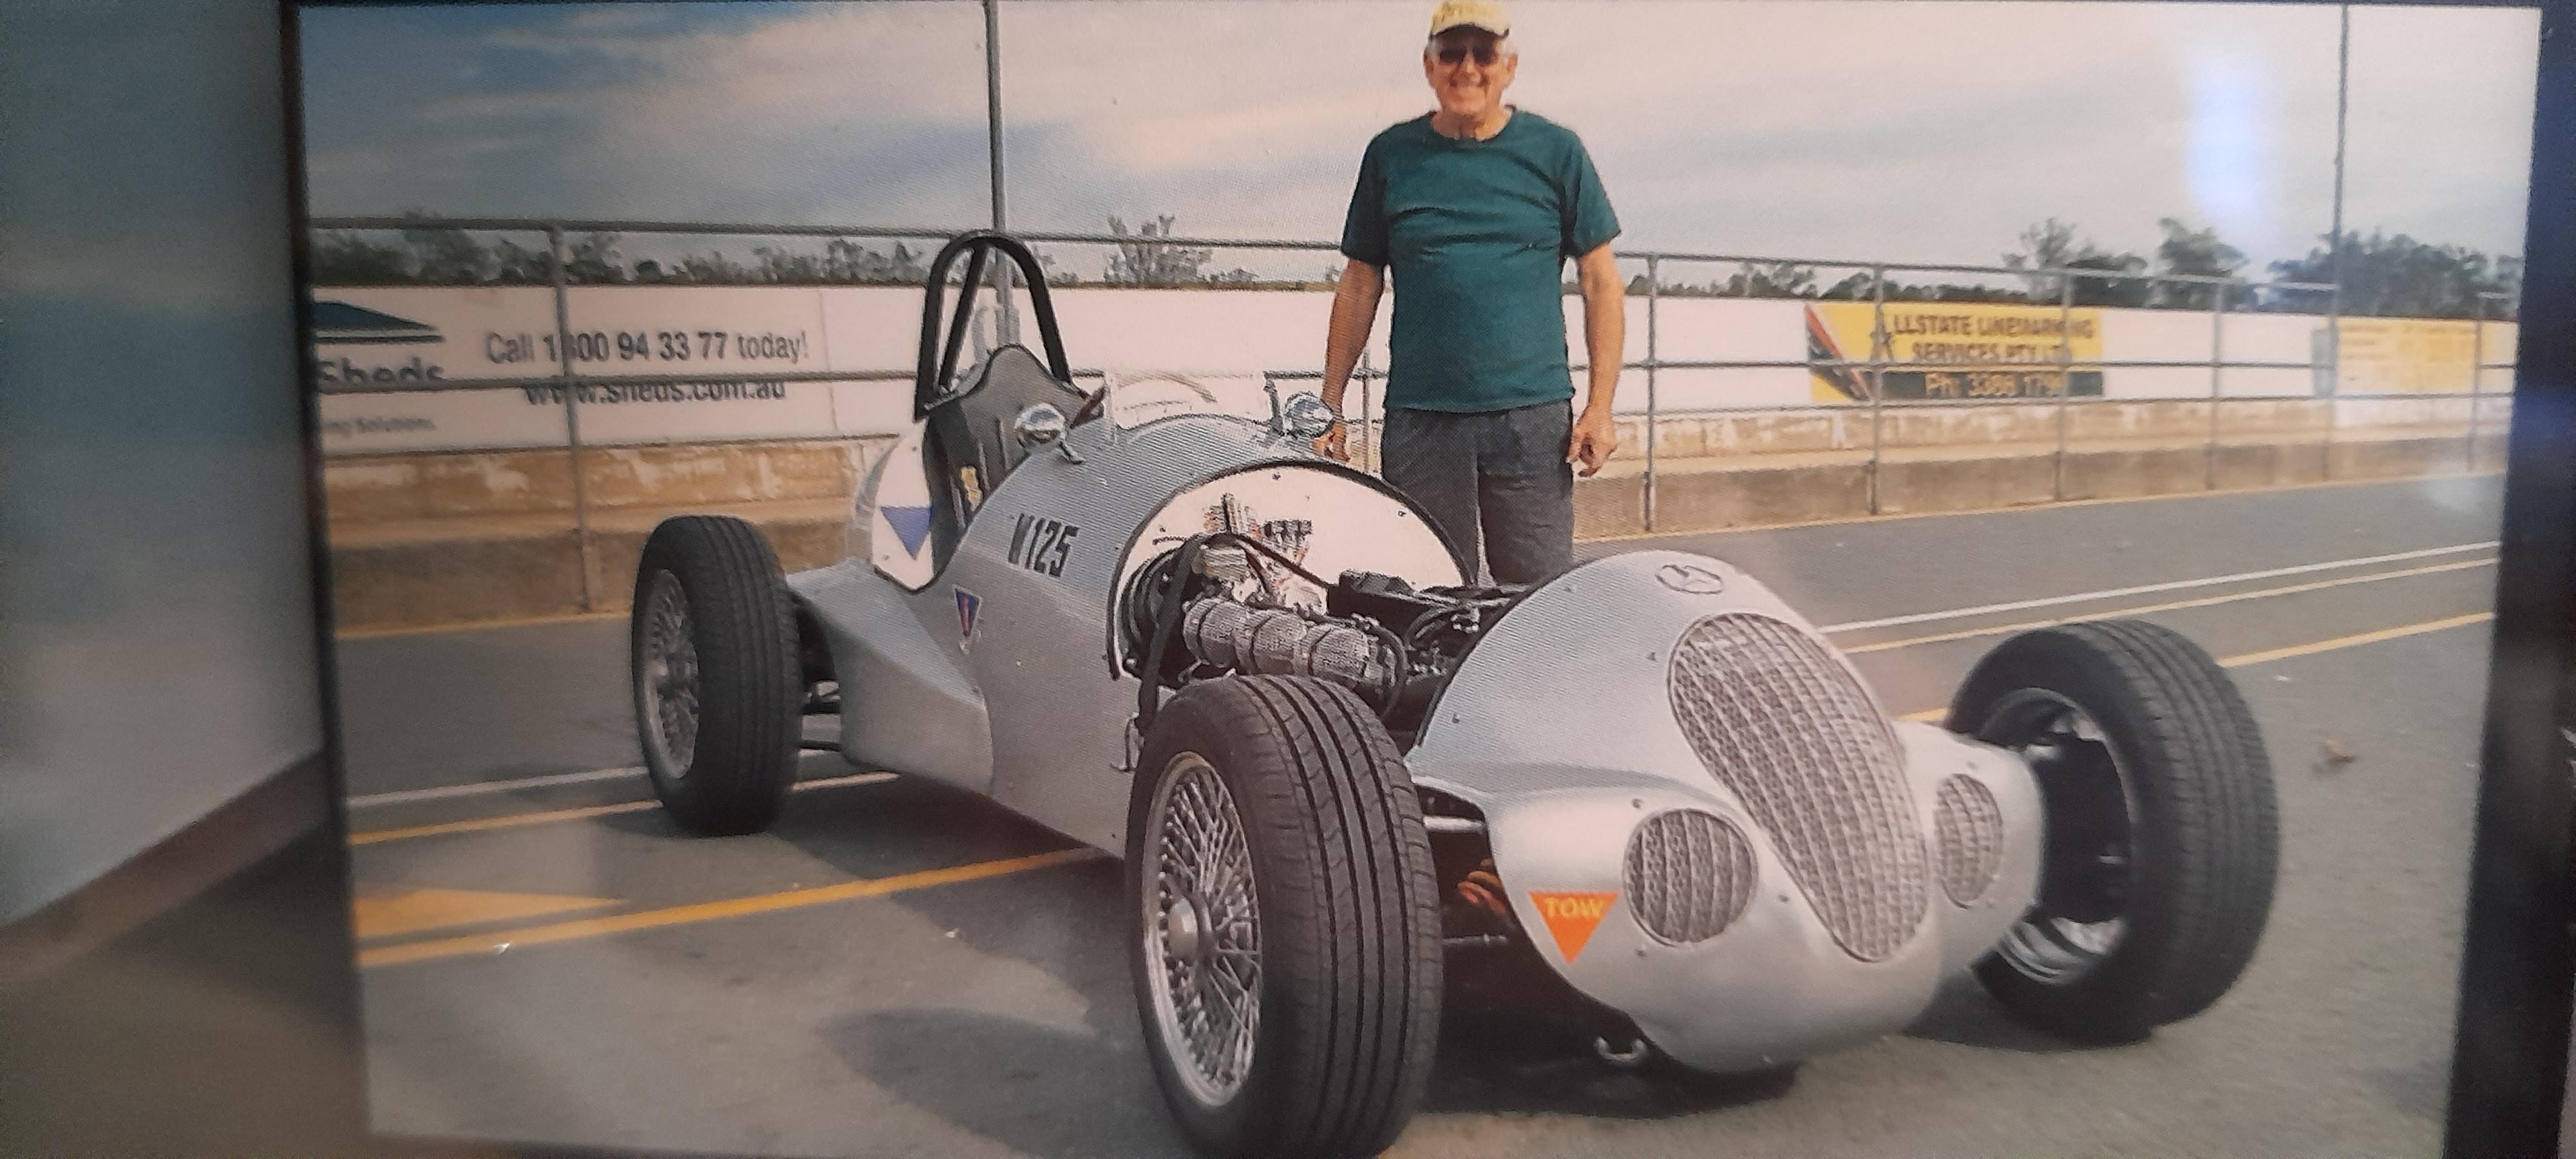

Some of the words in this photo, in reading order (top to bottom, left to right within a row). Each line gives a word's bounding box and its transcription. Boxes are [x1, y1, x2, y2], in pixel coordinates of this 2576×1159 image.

[487, 332, 535, 364] Call
[618, 330, 650, 361] 94
[658, 331, 692, 361] 33
[697, 330, 728, 359] 77
[737, 329, 809, 364] today!
[1545, 897, 1604, 918] TOW
